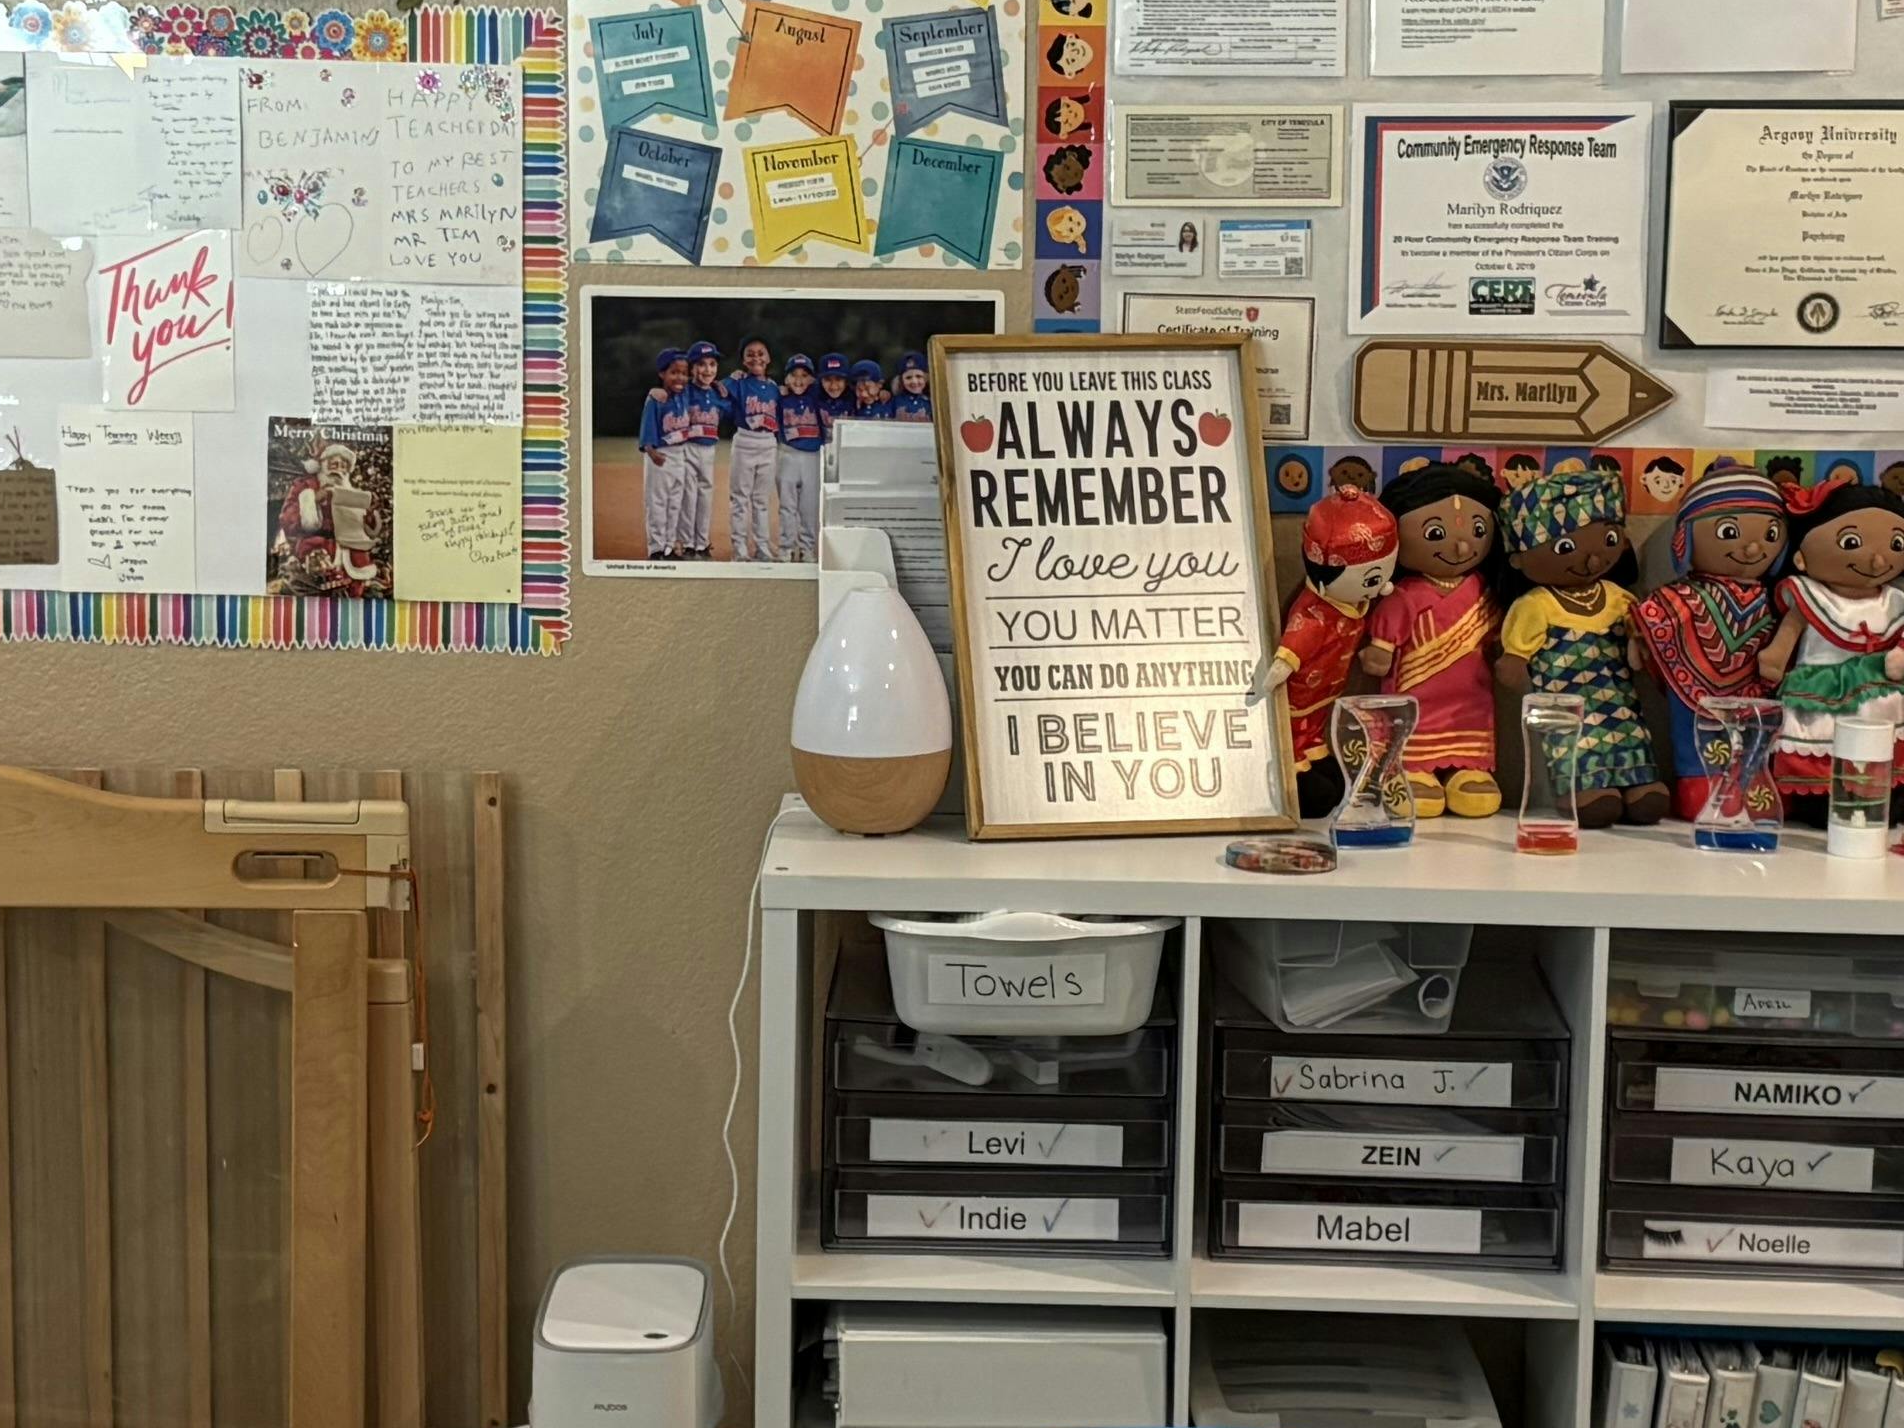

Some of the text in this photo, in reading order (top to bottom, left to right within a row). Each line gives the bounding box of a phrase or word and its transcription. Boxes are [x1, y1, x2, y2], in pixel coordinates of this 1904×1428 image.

[632, 23, 665, 47] July
[776, 18, 826, 45] August
[899, 20, 984, 46] September
[1398, 134, 1617, 161] Community Emergency Response Team
[1759, 125, 1897, 145] Argosy University
[637, 143, 691, 169] October
[763, 149, 840, 172] November
[912, 148, 981, 175] December
[390, 253, 482, 268] LOVE YOU
[99, 234, 220, 345] Thank
[127, 280, 235, 405] you!
[968, 370, 1212, 393] BEFORE YOU LEAVE THIS CLASS
[1476, 380, 1579, 404] Mrs. Marilyn
[274, 423, 392, 444] Merry Christmas
[996, 398, 1198, 460] ALWAYS
[970, 465, 1232, 528] REMEMBER
[987, 536, 1240, 593] I love you
[996, 606, 1243, 642] YOU MATTER
[994, 659, 1255, 692] YOU CAN DO ANYTHING
[1007, 709, 1253, 756] I BELIEVE
[1043, 756, 1223, 803] IN YOU
[945, 962, 1085, 1001] Towels
[1300, 1066, 1458, 1094] Sabrina J.
[1734, 1082, 1841, 1107] NAMIKO
[968, 1132, 1025, 1156] Levi
[1361, 1144, 1421, 1168] ZEIN
[1710, 1146, 1796, 1185] Kaya
[959, 1206, 1027, 1230] Indie
[1317, 1215, 1410, 1243] Mabel
[1738, 1232, 1811, 1255] Noelle
